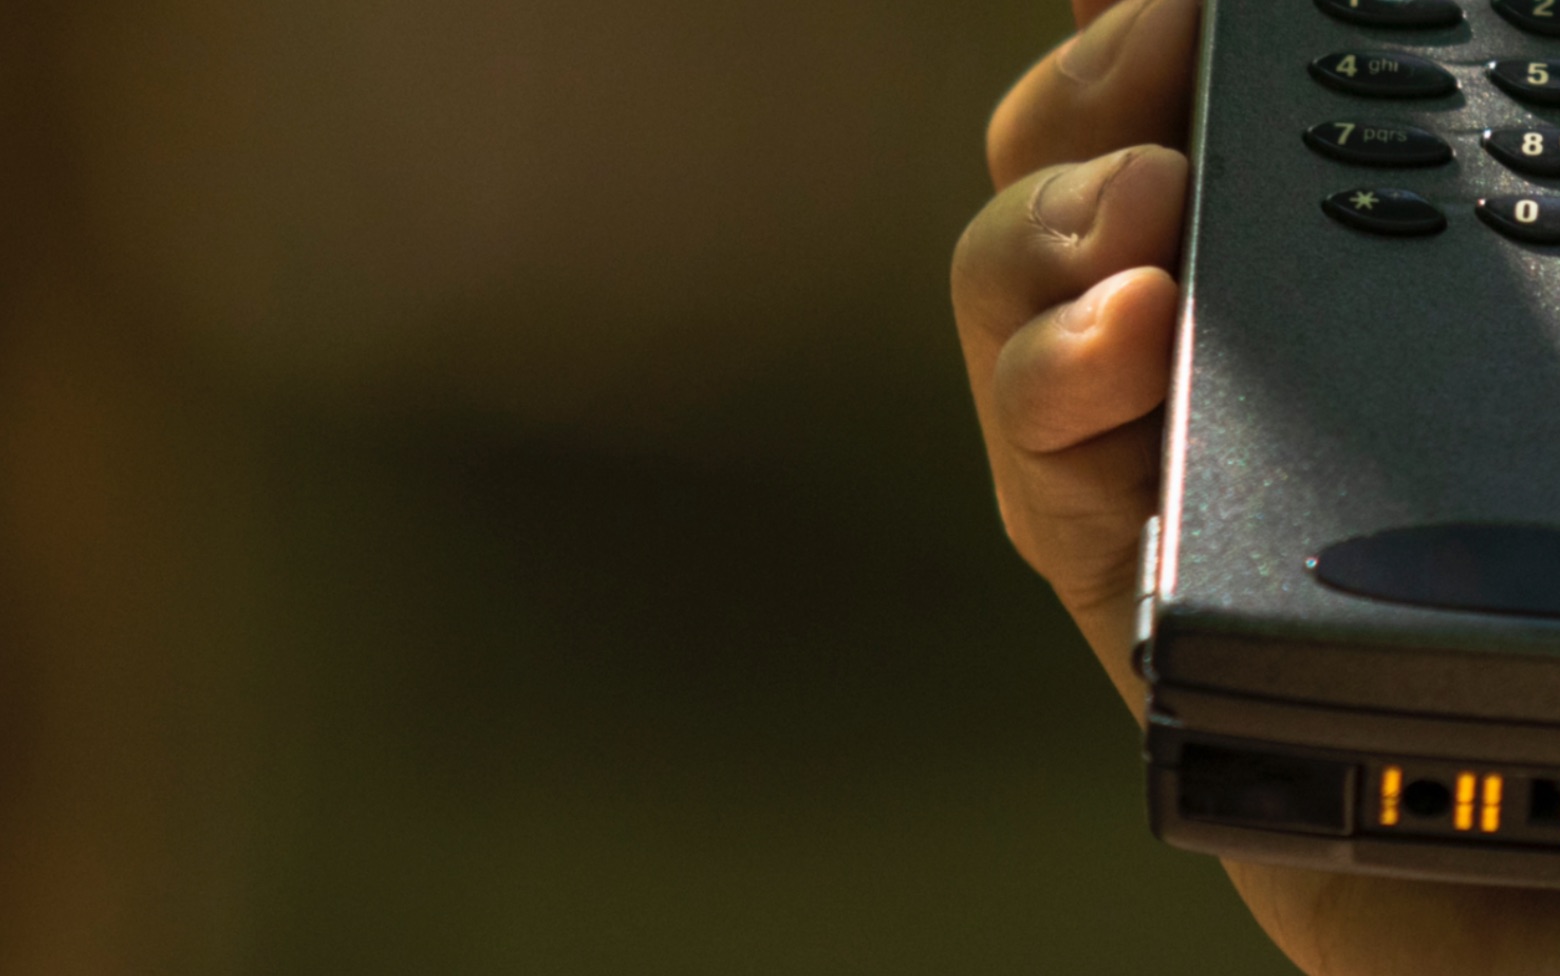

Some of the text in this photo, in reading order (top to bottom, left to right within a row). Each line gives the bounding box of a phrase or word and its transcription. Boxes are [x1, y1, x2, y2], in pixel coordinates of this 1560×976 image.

[1335, 54, 1399, 77] 4 ghi
[1526, 62, 1550, 85] 5
[1333, 122, 1408, 146] 7 pqrs
[1521, 132, 1544, 156] 8
[1514, 199, 1540, 224] 0
